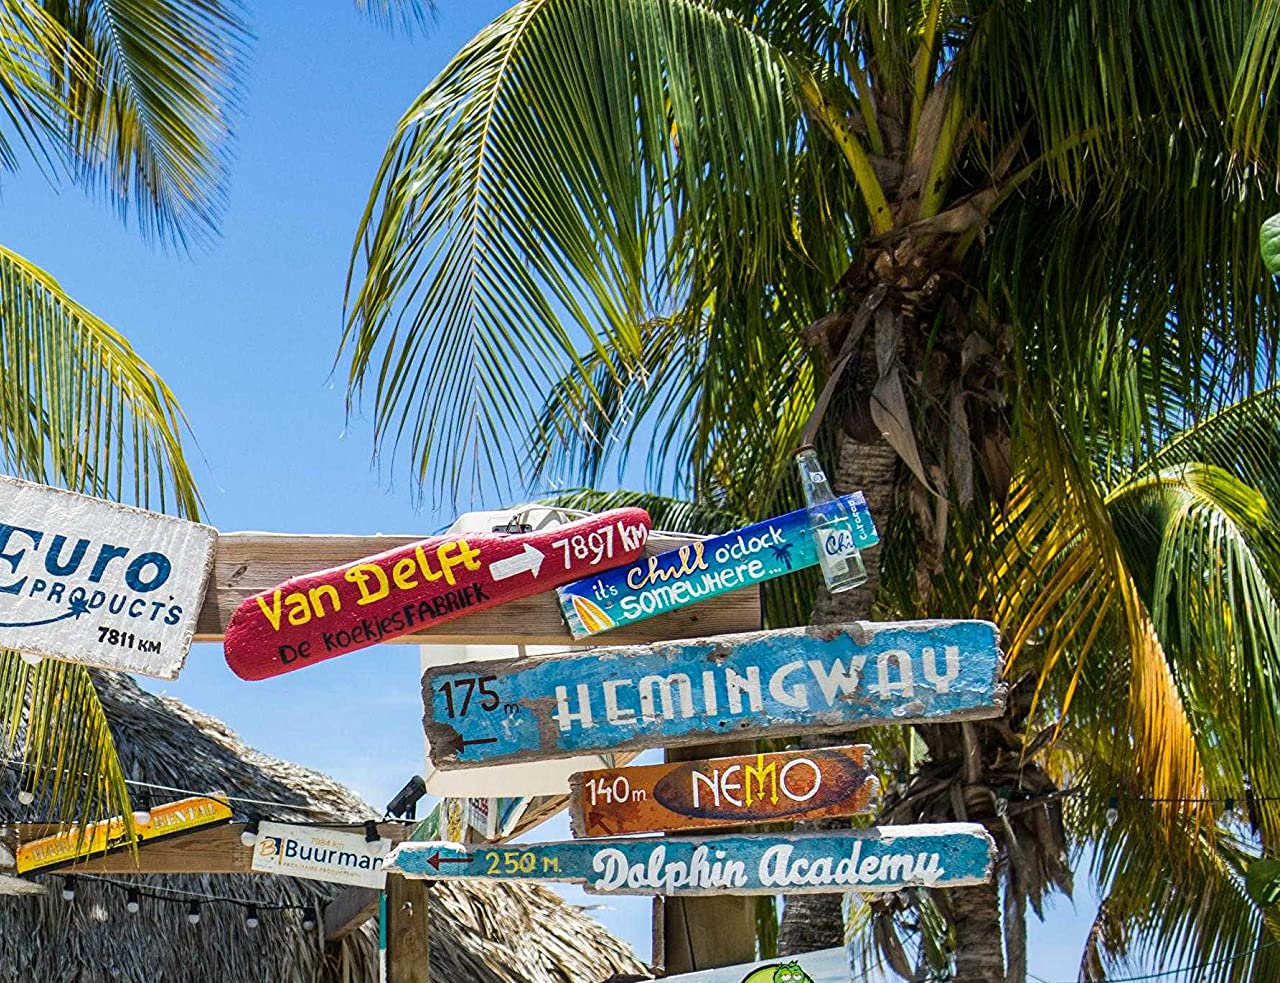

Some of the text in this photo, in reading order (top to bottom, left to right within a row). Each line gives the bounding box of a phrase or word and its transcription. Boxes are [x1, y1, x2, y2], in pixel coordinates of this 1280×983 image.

[553, 519, 648, 569] 7897 km
[592, 579, 619, 601] it's
[715, 525, 787, 563] o'clock
[29, 578, 184, 625] PRODUCTS
[256, 539, 482, 631] Van Delft
[98, 626, 162, 654] 7811 KM
[552, 645, 961, 731] HEMINGWAY
[692, 754, 822, 808] NEMO
[285, 839, 384, 871] Buurman
[486, 850, 537, 874] 250
[593, 847, 739, 894] Dolphin
[757, 840, 945, 887] Academy
